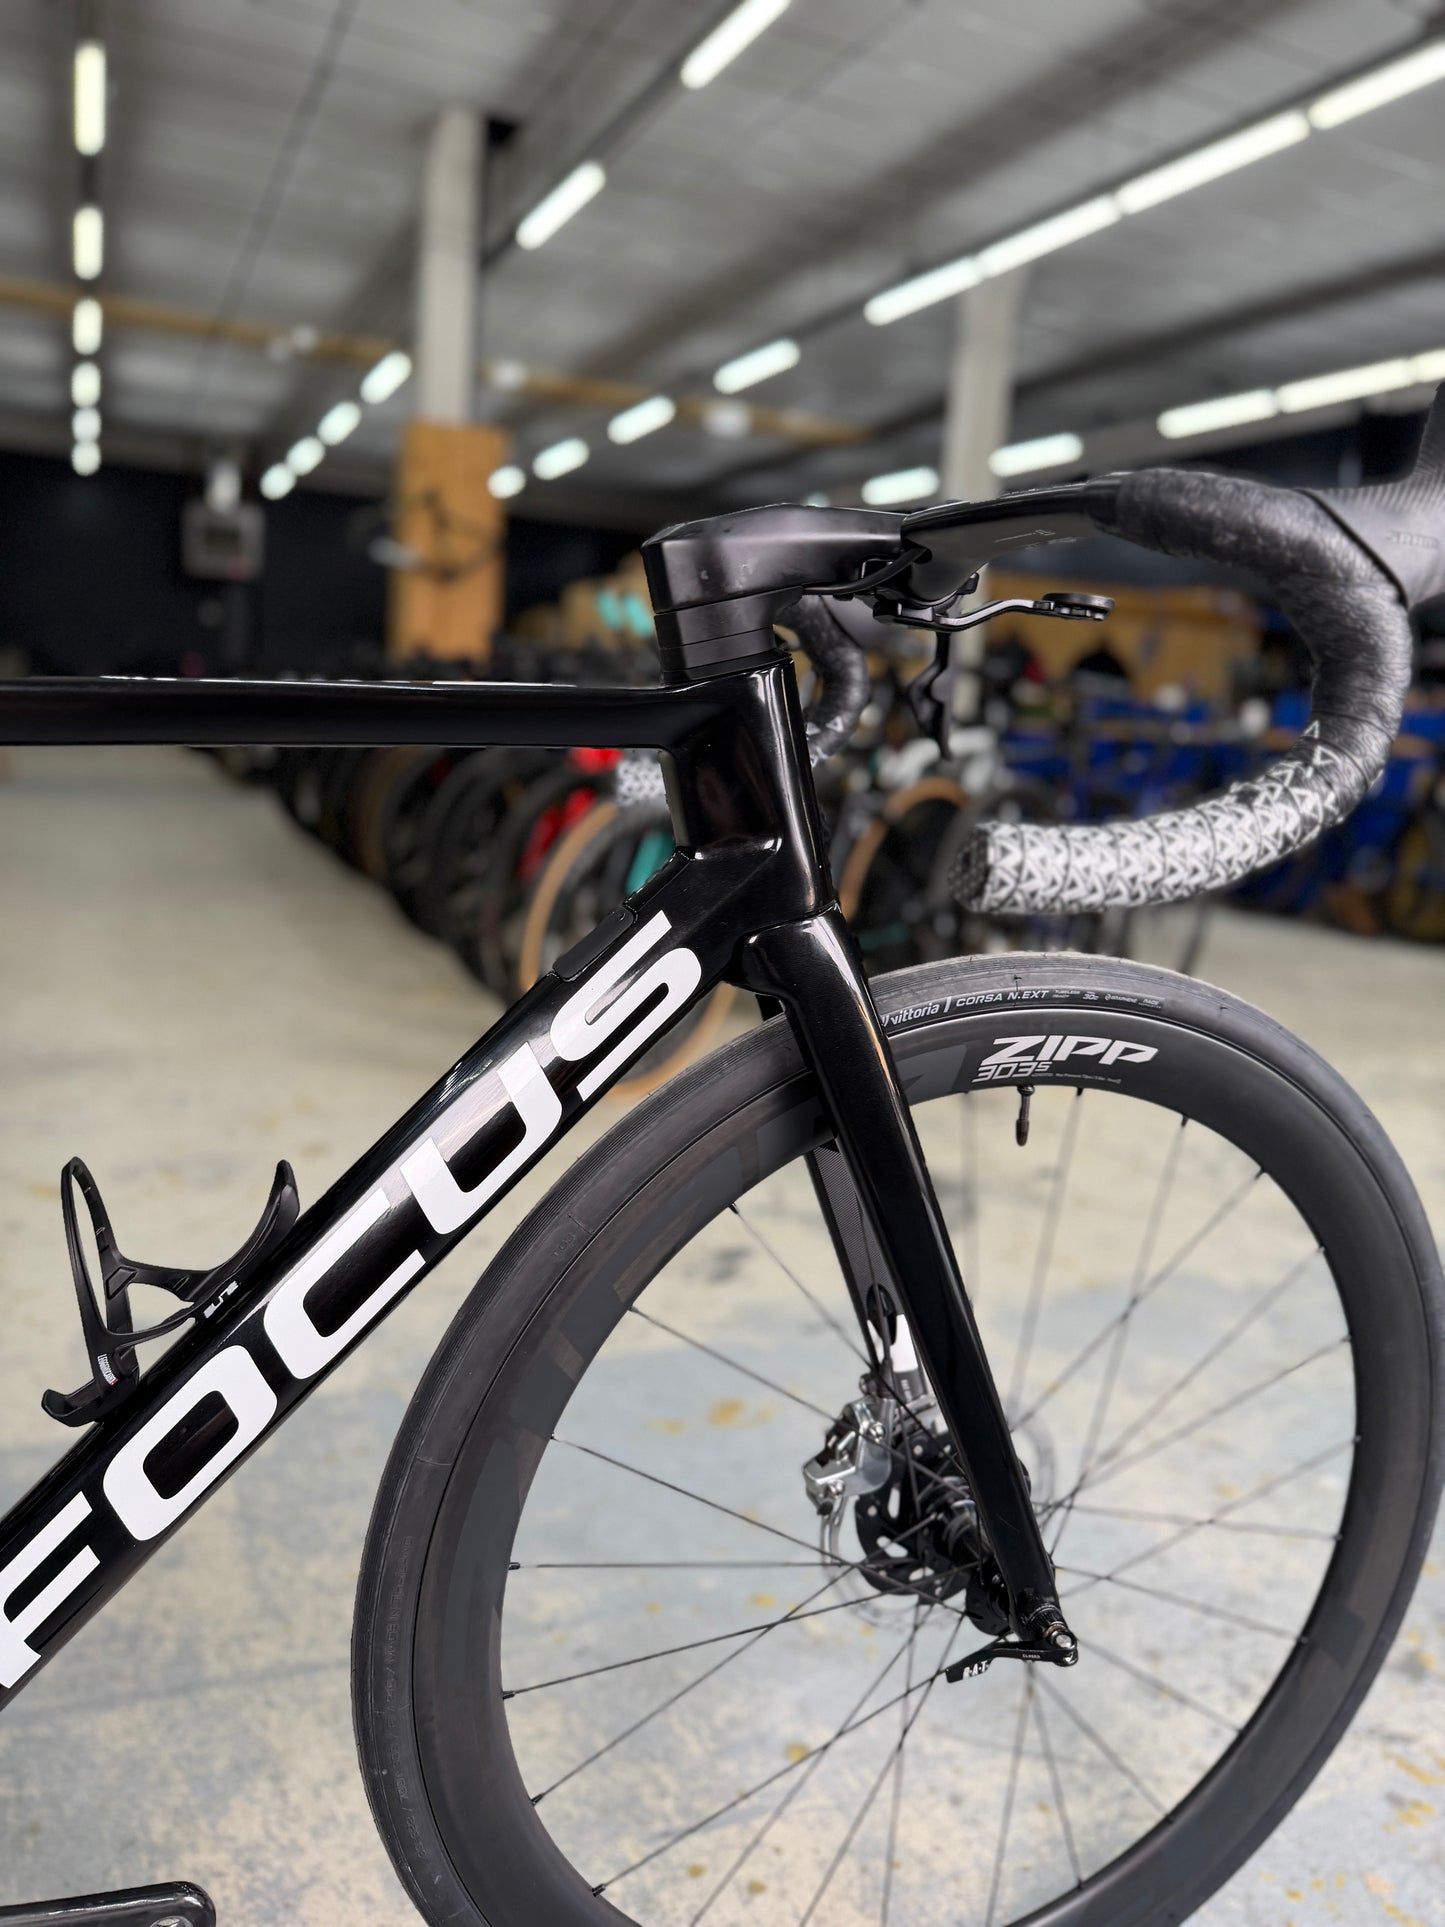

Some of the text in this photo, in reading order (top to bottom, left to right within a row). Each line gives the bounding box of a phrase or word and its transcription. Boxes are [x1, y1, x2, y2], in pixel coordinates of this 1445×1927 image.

[890, 989, 1049, 1026] vittoria CORSA N.EXT
[982, 1035, 1159, 1066] ZIPP
[0, 909, 702, 1688] FOCUS
